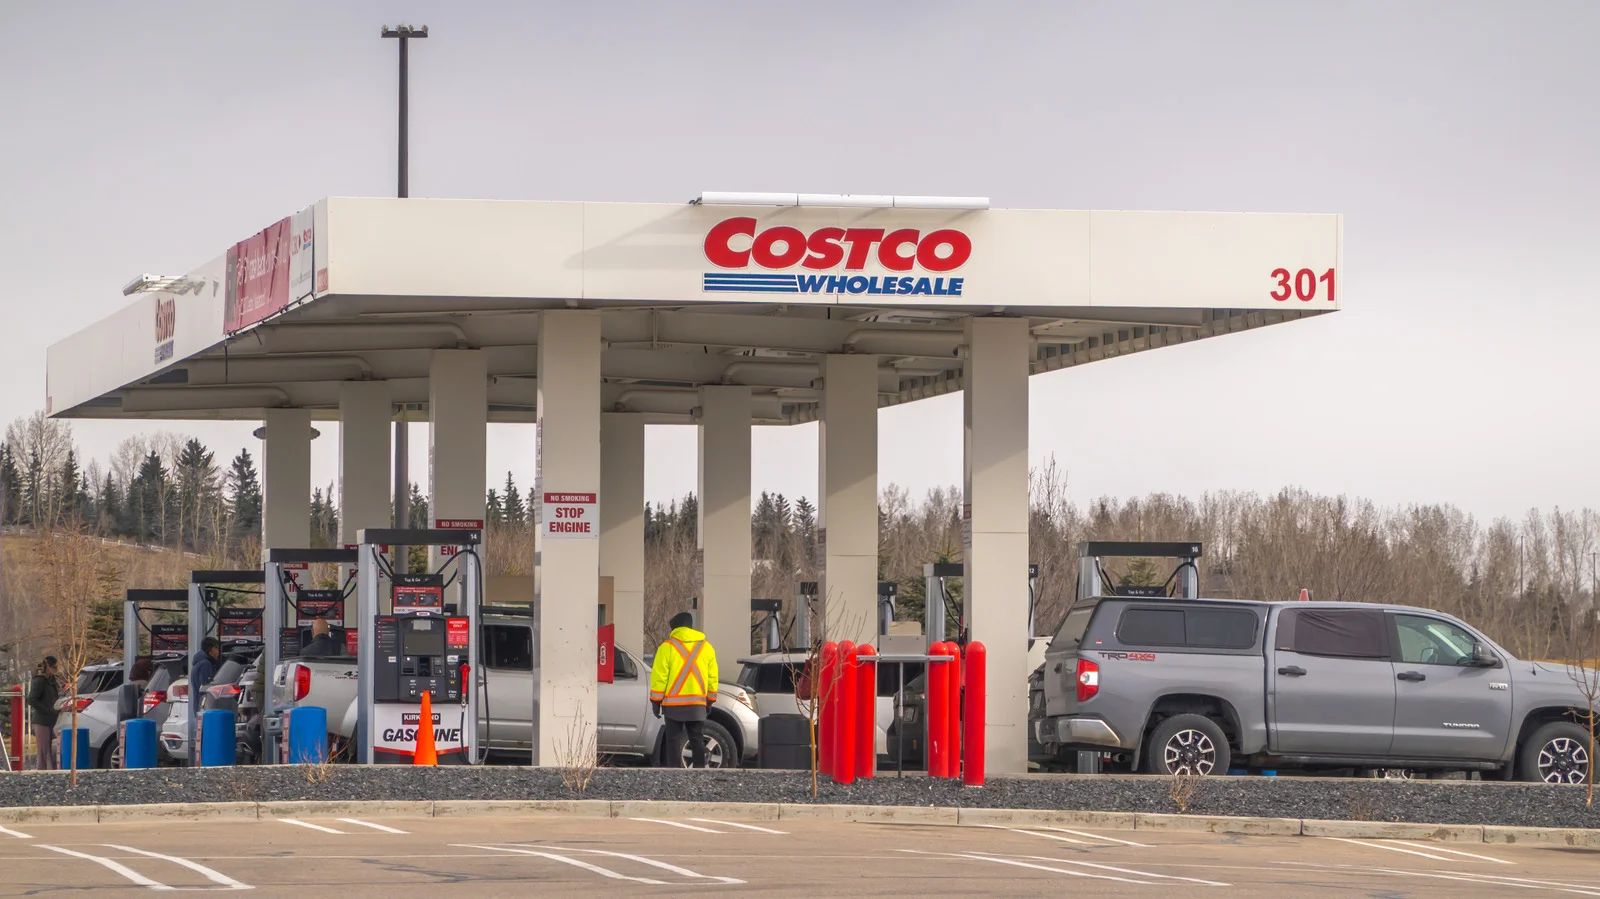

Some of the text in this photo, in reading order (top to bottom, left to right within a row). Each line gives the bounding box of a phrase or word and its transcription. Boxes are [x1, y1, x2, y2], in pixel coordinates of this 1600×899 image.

[704, 217, 971, 271] COSTCO
[797, 274, 964, 295] WHOLESALE
[1270, 268, 1335, 301] 301
[555, 507, 585, 518] STOP
[549, 521, 591, 533] ENGINE
